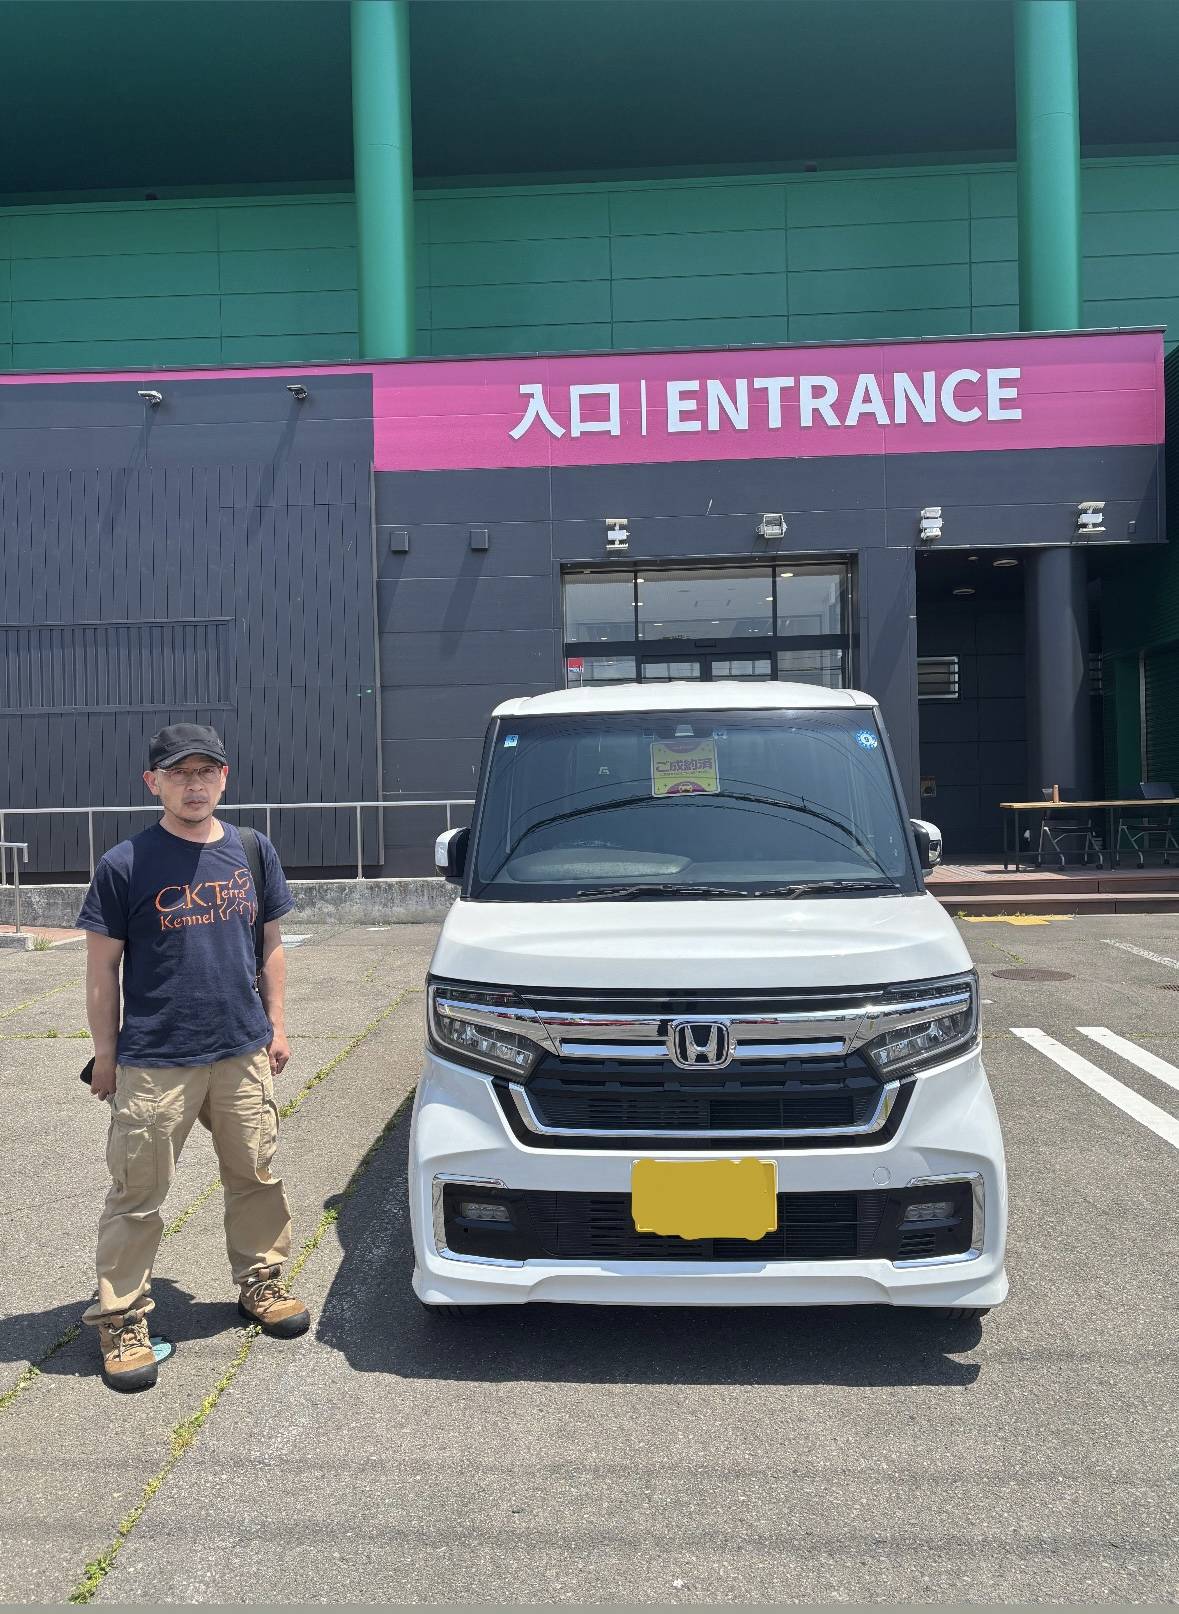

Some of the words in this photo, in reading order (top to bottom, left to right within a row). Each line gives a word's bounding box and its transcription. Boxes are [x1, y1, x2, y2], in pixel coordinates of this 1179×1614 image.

[510, 383, 620, 440] 入口
[667, 367, 1022, 433] ENTRANCE
[160, 909, 215, 930] Kennel
